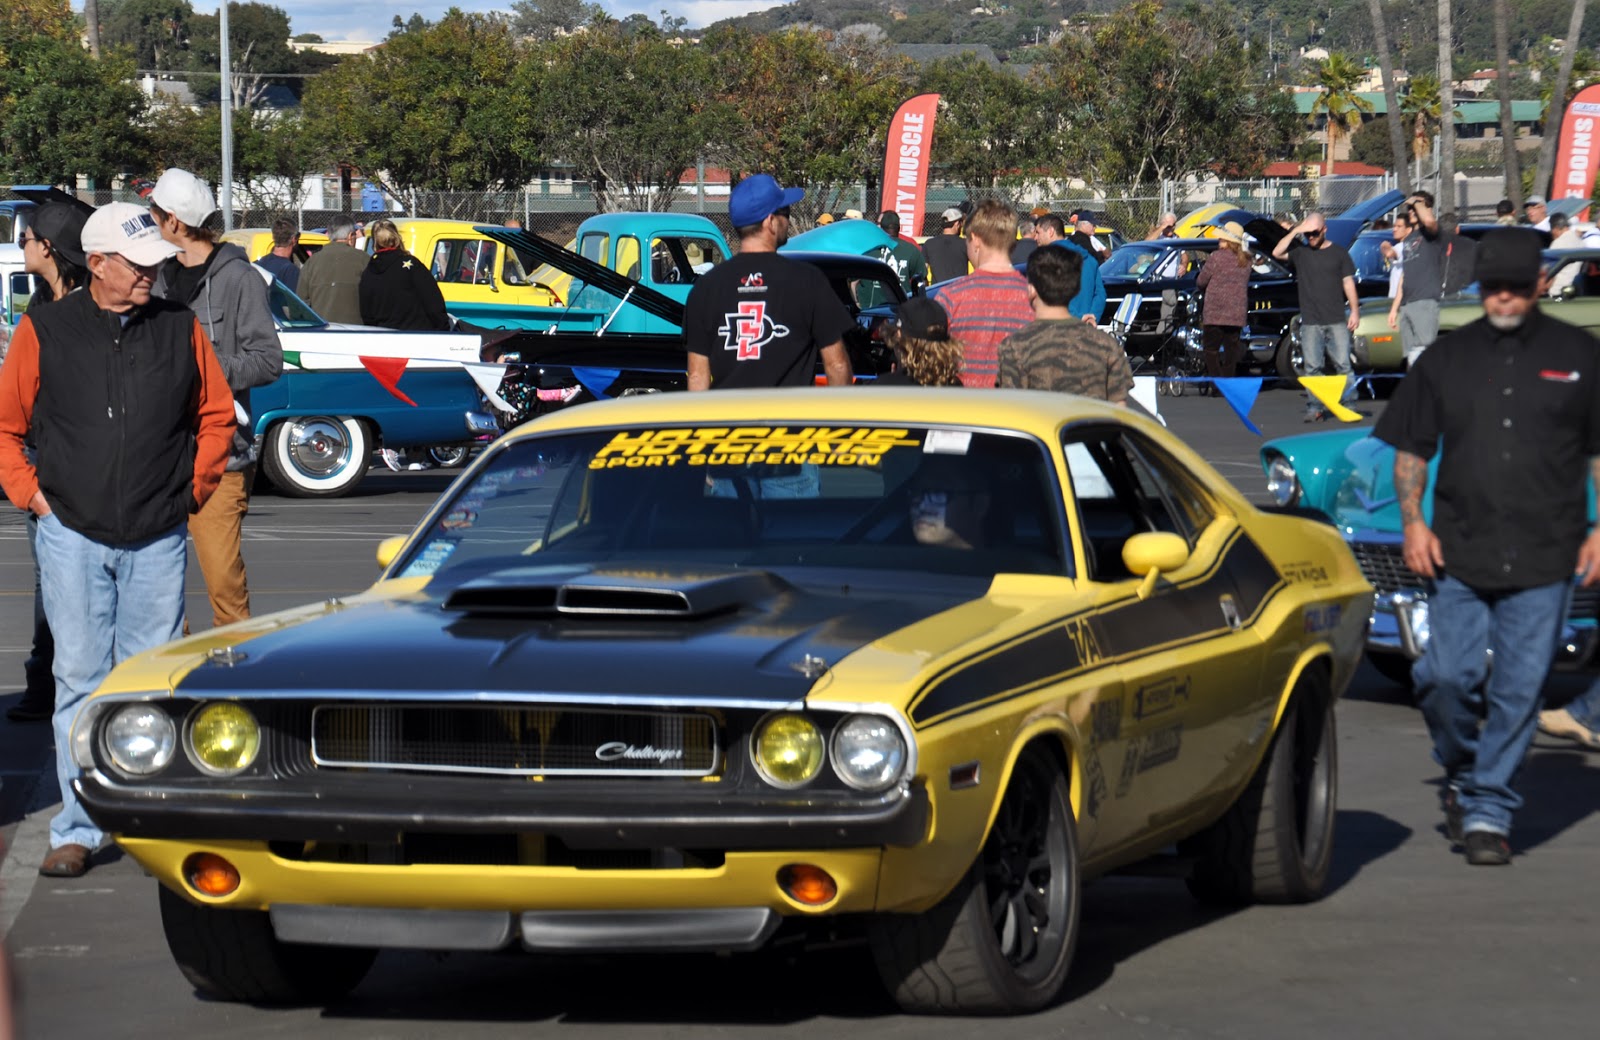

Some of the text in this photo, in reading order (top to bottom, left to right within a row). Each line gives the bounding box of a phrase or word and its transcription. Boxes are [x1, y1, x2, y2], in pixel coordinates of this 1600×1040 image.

[897, 112, 925, 187] MUSCLE
[595, 427, 920, 458] HOTCHKIS
[588, 452, 882, 470] SPORT SUSPENSION
[595, 741, 683, 764] Challenger
